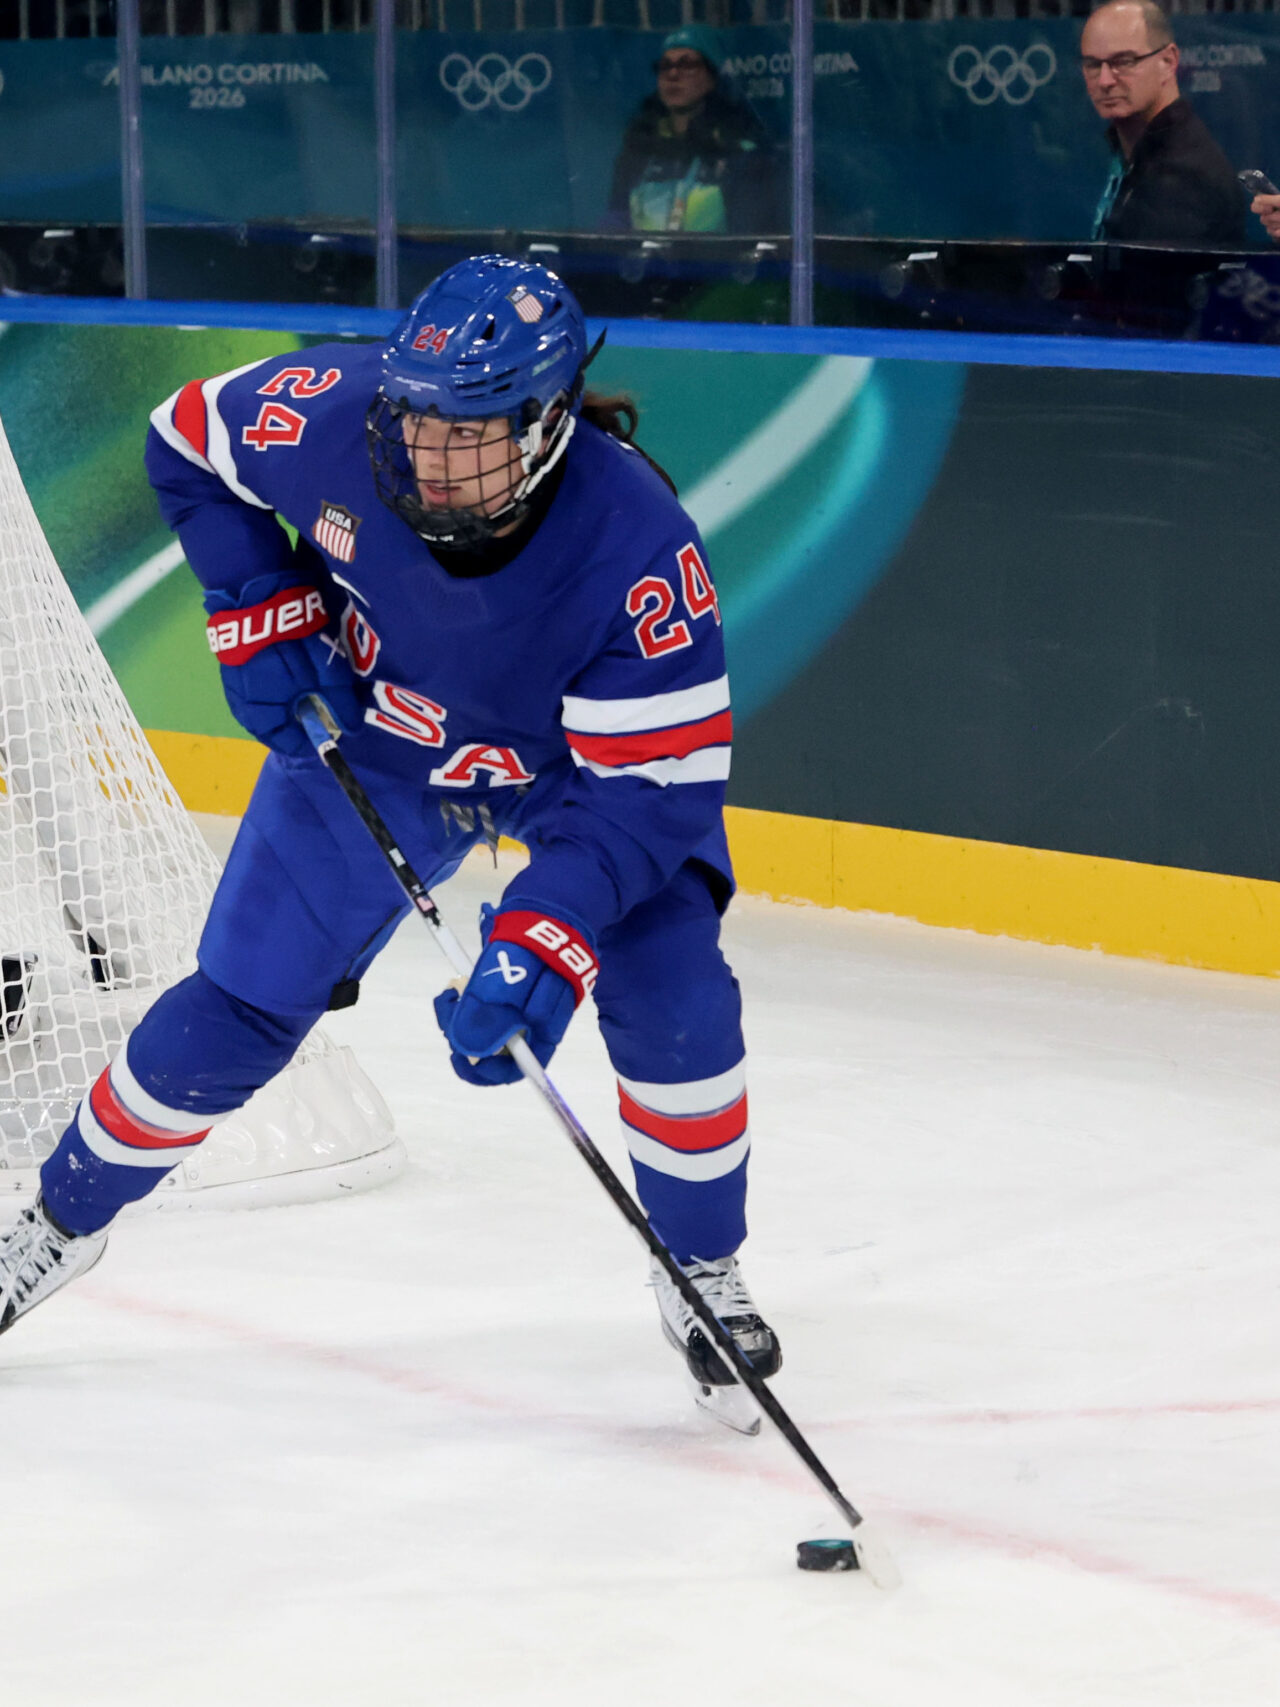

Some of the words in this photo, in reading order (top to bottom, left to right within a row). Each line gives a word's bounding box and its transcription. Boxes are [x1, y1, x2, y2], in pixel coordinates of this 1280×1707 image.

[219, 63, 330, 84] CORTINA
[189, 87, 246, 108] 2026
[412, 323, 447, 355] 24
[242, 366, 342, 451] 24
[325, 507, 353, 532] USA
[625, 541, 721, 660] 24
[339, 592, 537, 789] USA
